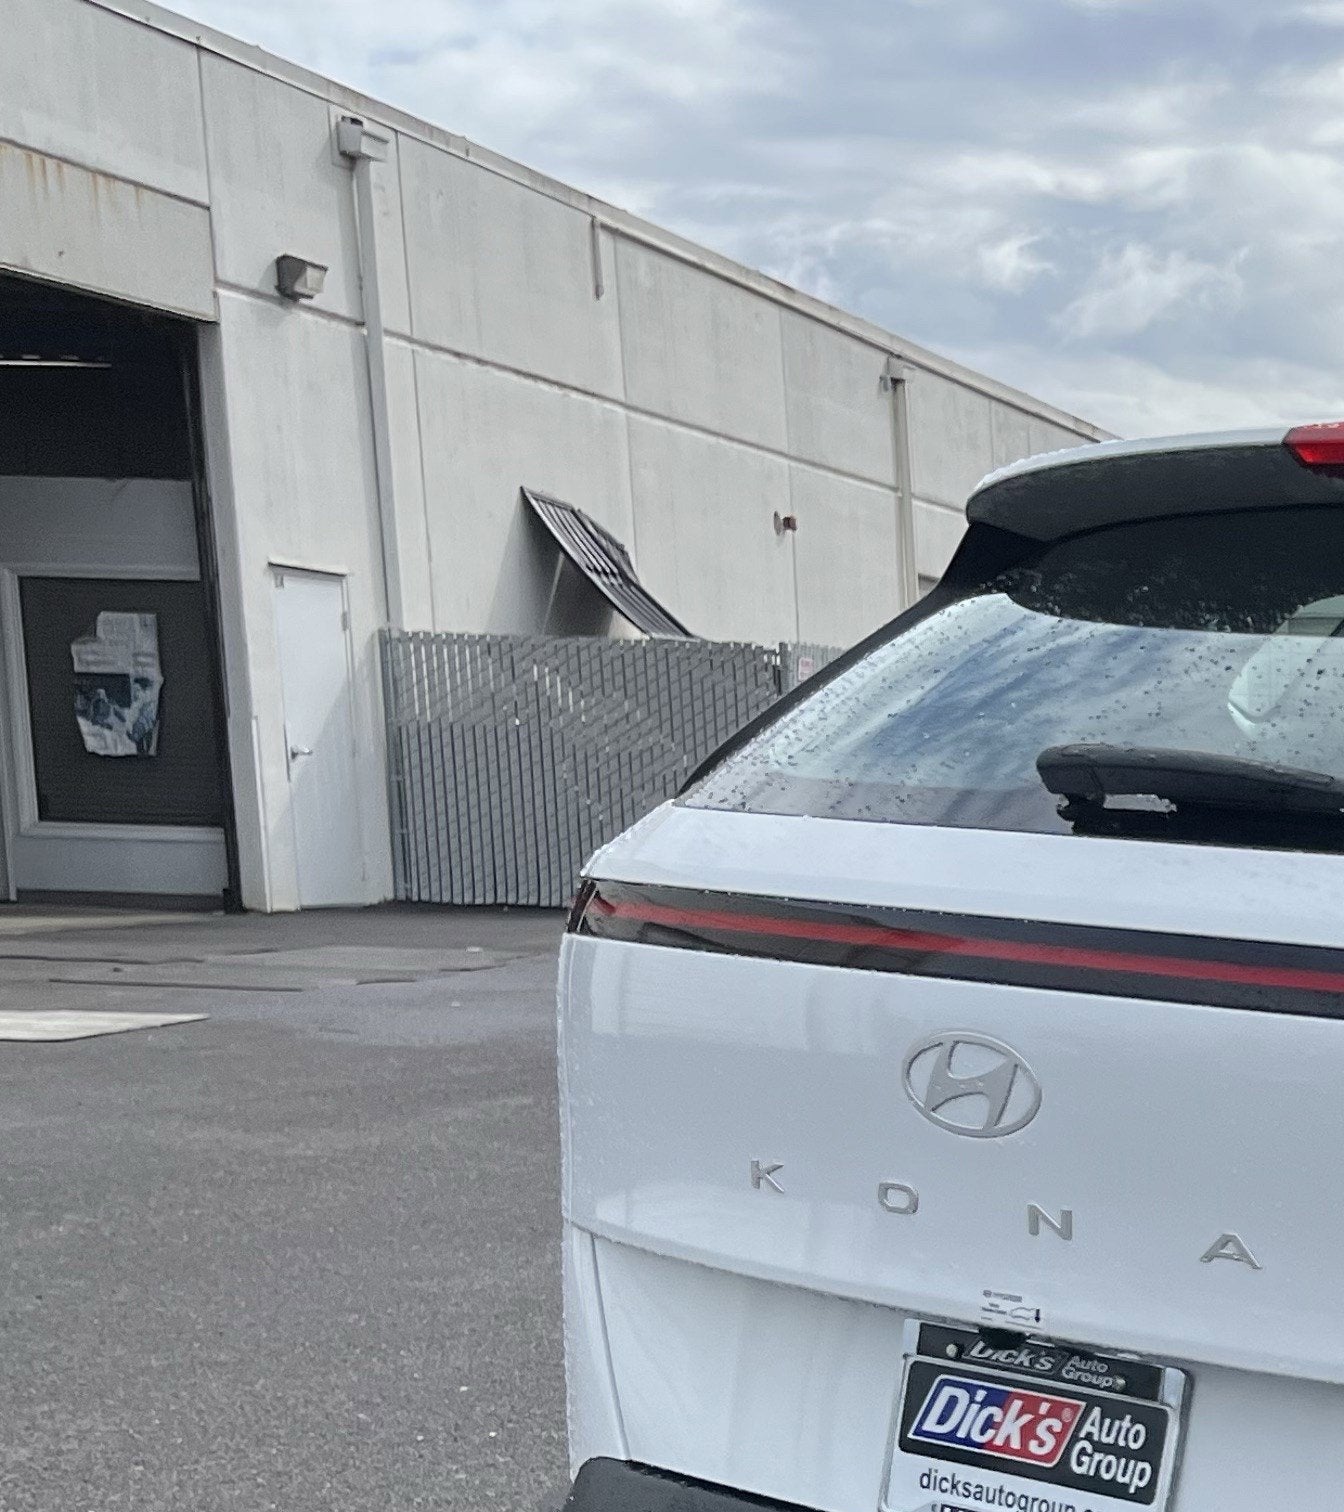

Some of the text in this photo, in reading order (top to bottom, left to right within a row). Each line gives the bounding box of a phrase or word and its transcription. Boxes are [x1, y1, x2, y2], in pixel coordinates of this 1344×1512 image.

[750, 1159, 1263, 1271] KONA
[1061, 1366, 1114, 1389] Group
[1066, 1355, 1109, 1373] Auto
[921, 1384, 1147, 1456] Dick's Auto
[1069, 1440, 1152, 1494] Group
